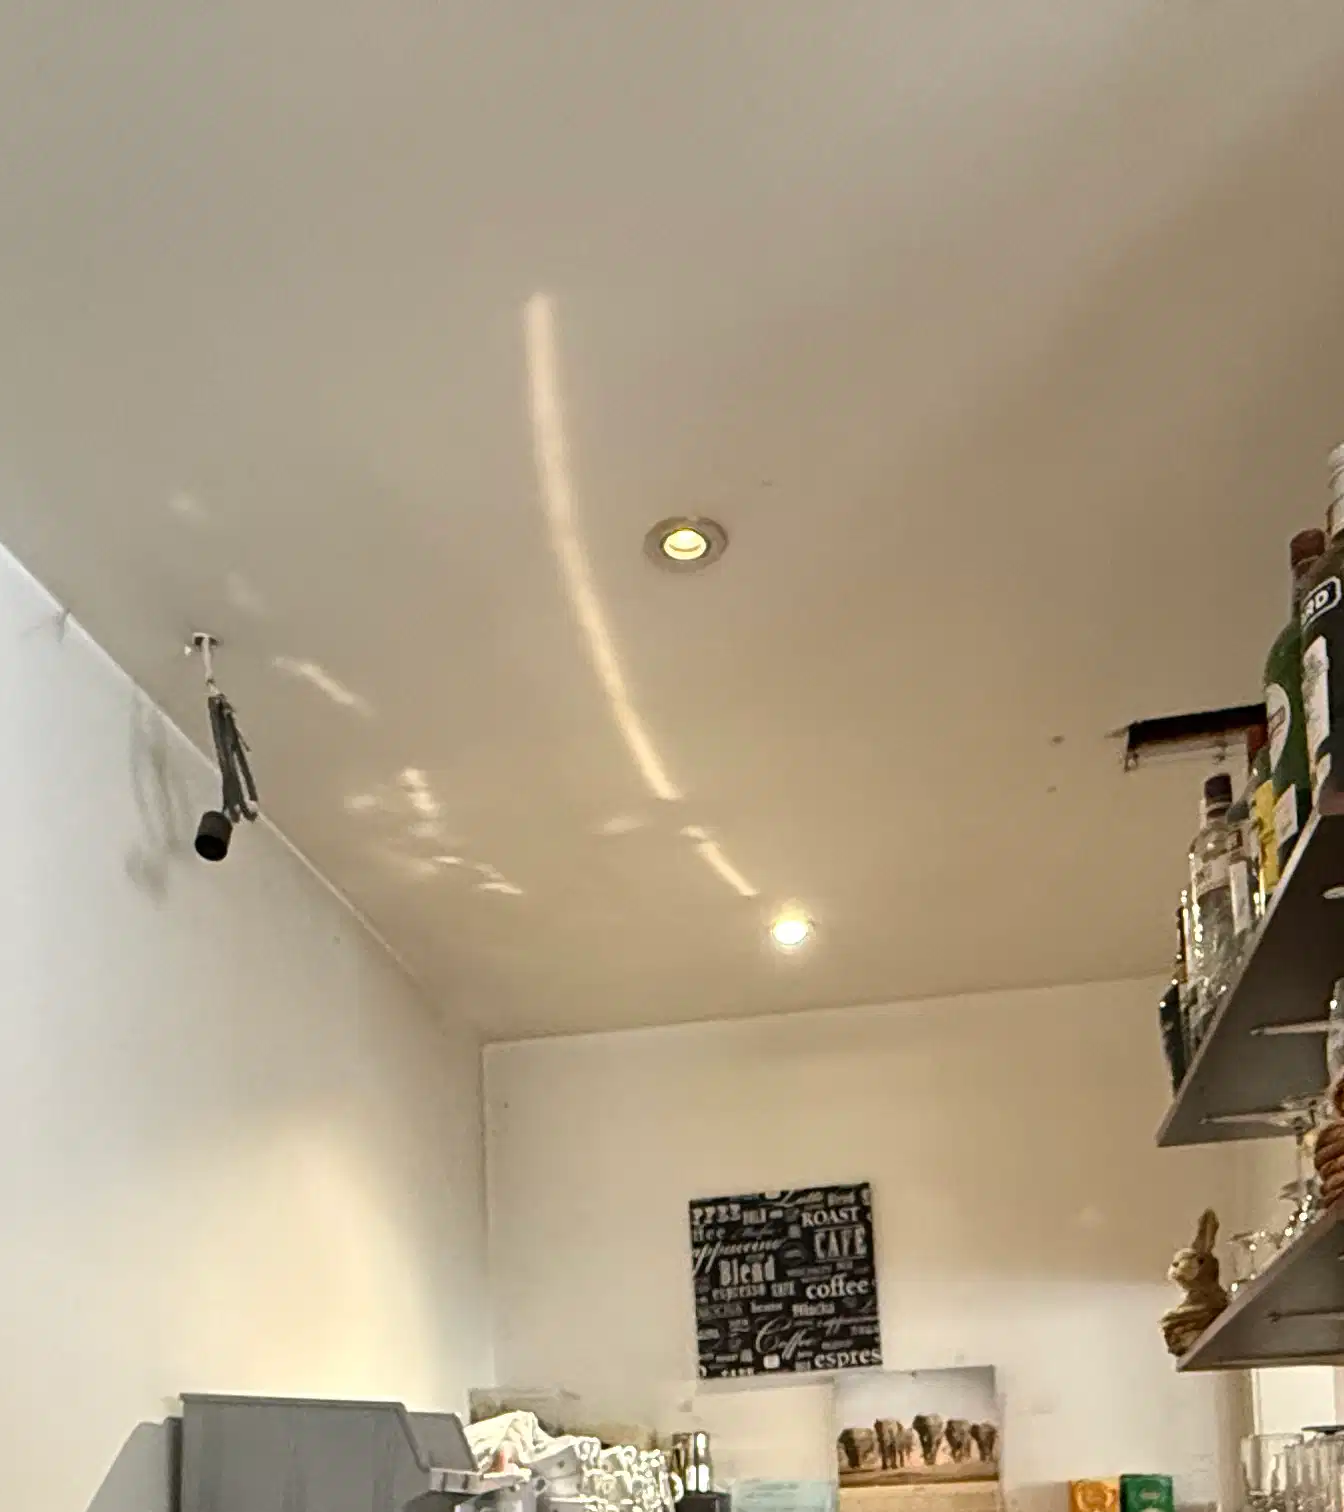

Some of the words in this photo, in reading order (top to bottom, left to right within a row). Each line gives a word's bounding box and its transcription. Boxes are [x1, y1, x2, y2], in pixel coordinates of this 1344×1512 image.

[801, 1206, 861, 1228] ROAST
[719, 1254, 776, 1286] Blend
[805, 1272, 869, 1299] coffee
